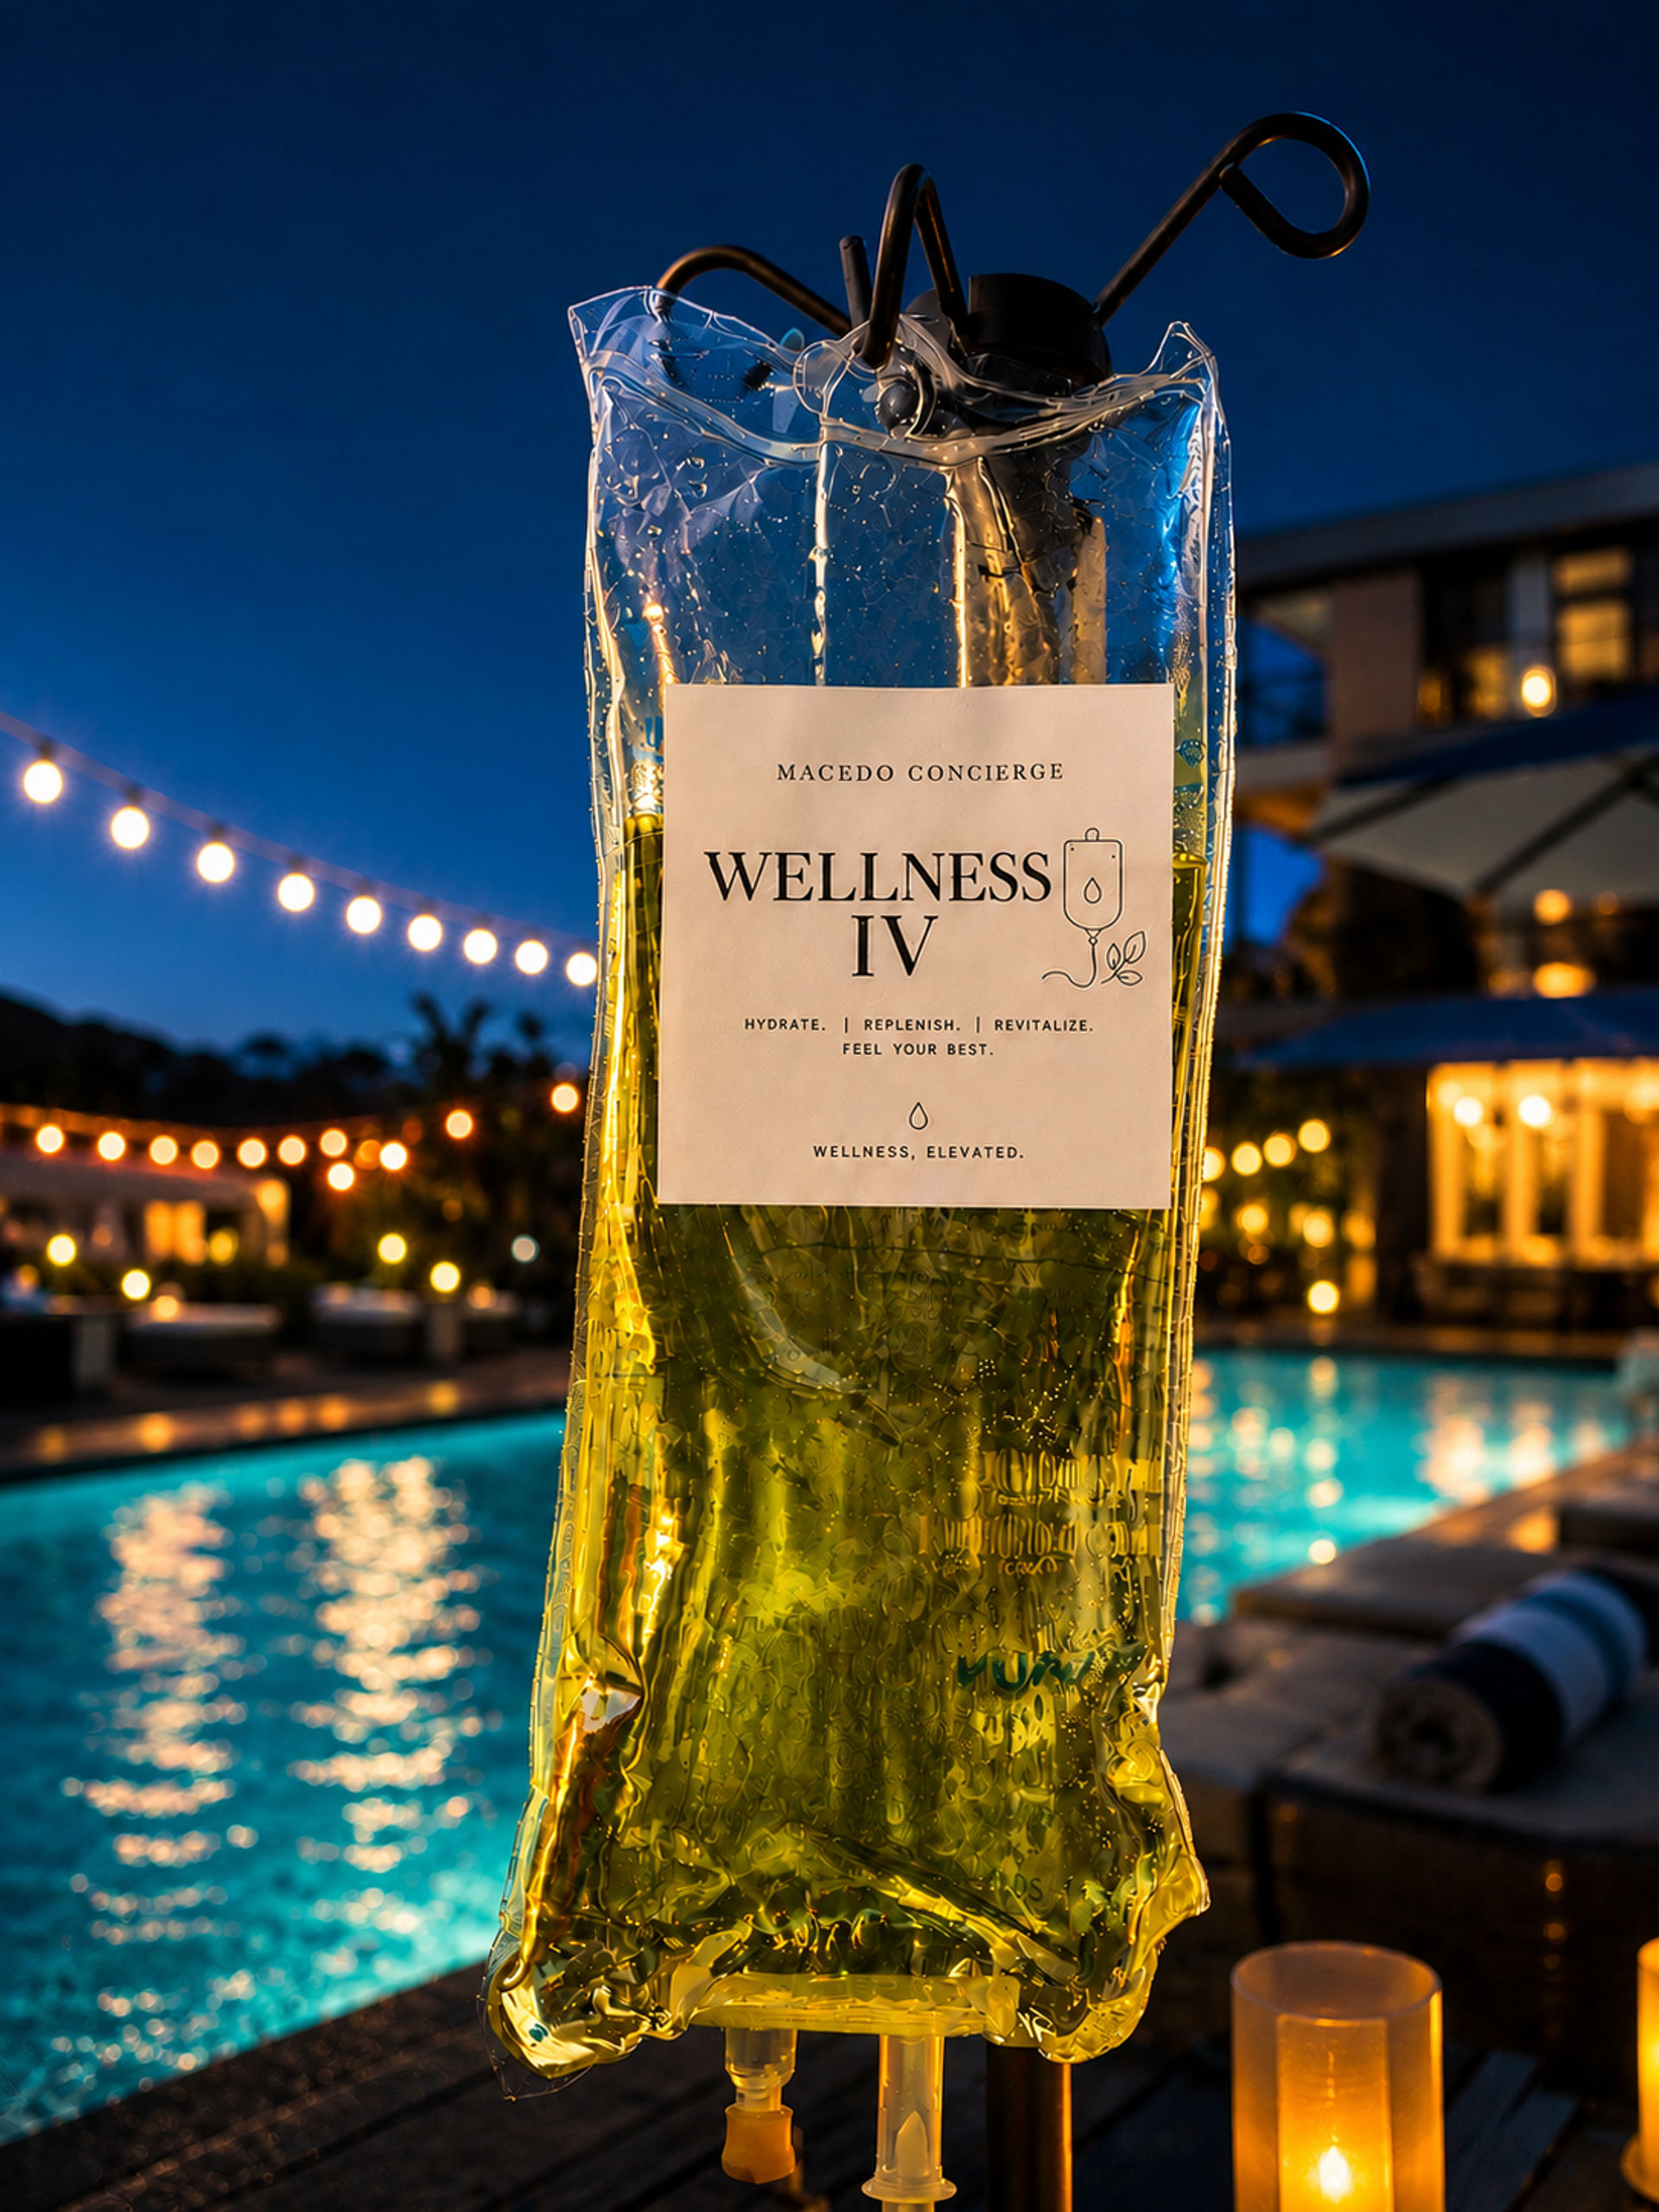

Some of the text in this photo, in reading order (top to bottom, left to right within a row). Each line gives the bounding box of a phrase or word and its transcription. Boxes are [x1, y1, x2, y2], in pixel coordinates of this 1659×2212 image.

[777, 763, 1063, 782] MACEDO CONCIERGE
[702, 850, 1052, 903] WELLNESS
[850, 914, 939, 977] IV
[744, 1018, 826, 1032] HYDRATE.
[864, 1018, 961, 1032] REPLENISH.
[994, 1019, 1093, 1033] REVITALIZE.
[842, 1042, 994, 1057] FEEL YOUR BEST.
[812, 1145, 1024, 1161] WELLNESS, ELEVATED.
